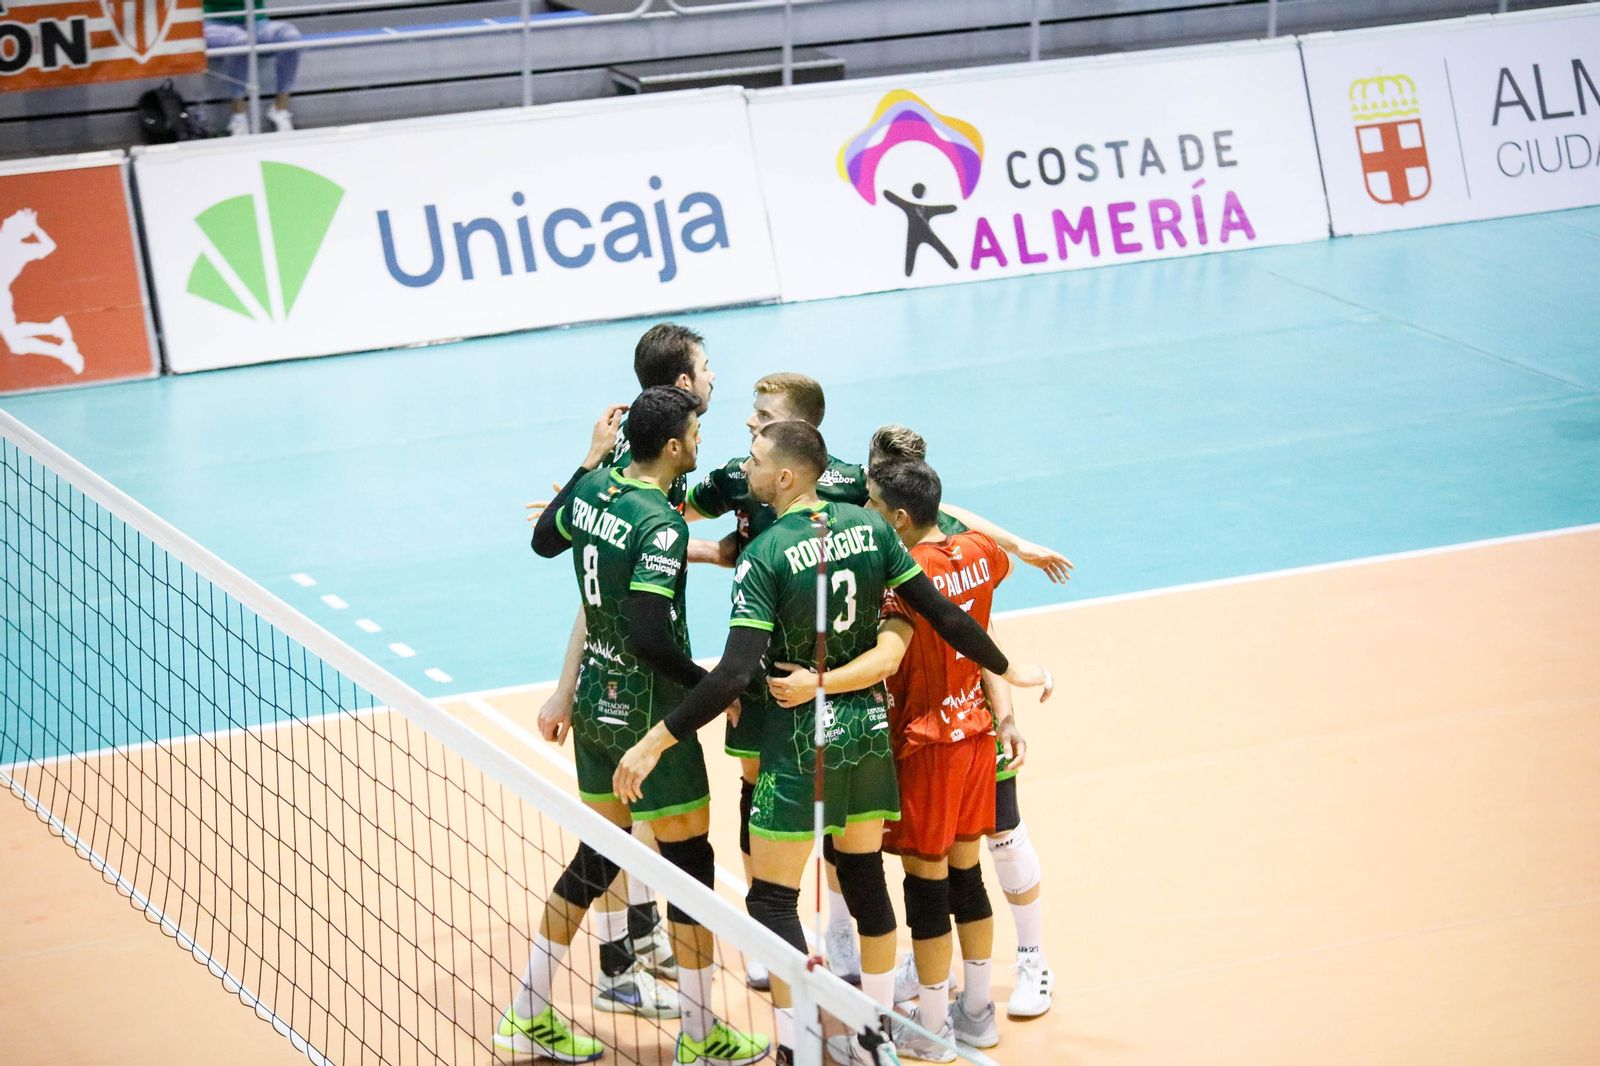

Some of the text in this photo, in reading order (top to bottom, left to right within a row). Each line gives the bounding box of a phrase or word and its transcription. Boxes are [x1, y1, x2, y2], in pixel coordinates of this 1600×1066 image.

[1006, 130, 1238, 189] COSTA DE
[1497, 133, 1600, 178] CIUD
[376, 175, 730, 288] Unicaja
[970, 177, 1257, 271] ALMERÍA
[583, 543, 602, 608] 8
[641, 552, 682, 569] Fundación
[645, 560, 677, 576] Unicaja
[784, 525, 878, 575] RODRÍGUEZ
[831, 568, 857, 634] 3
